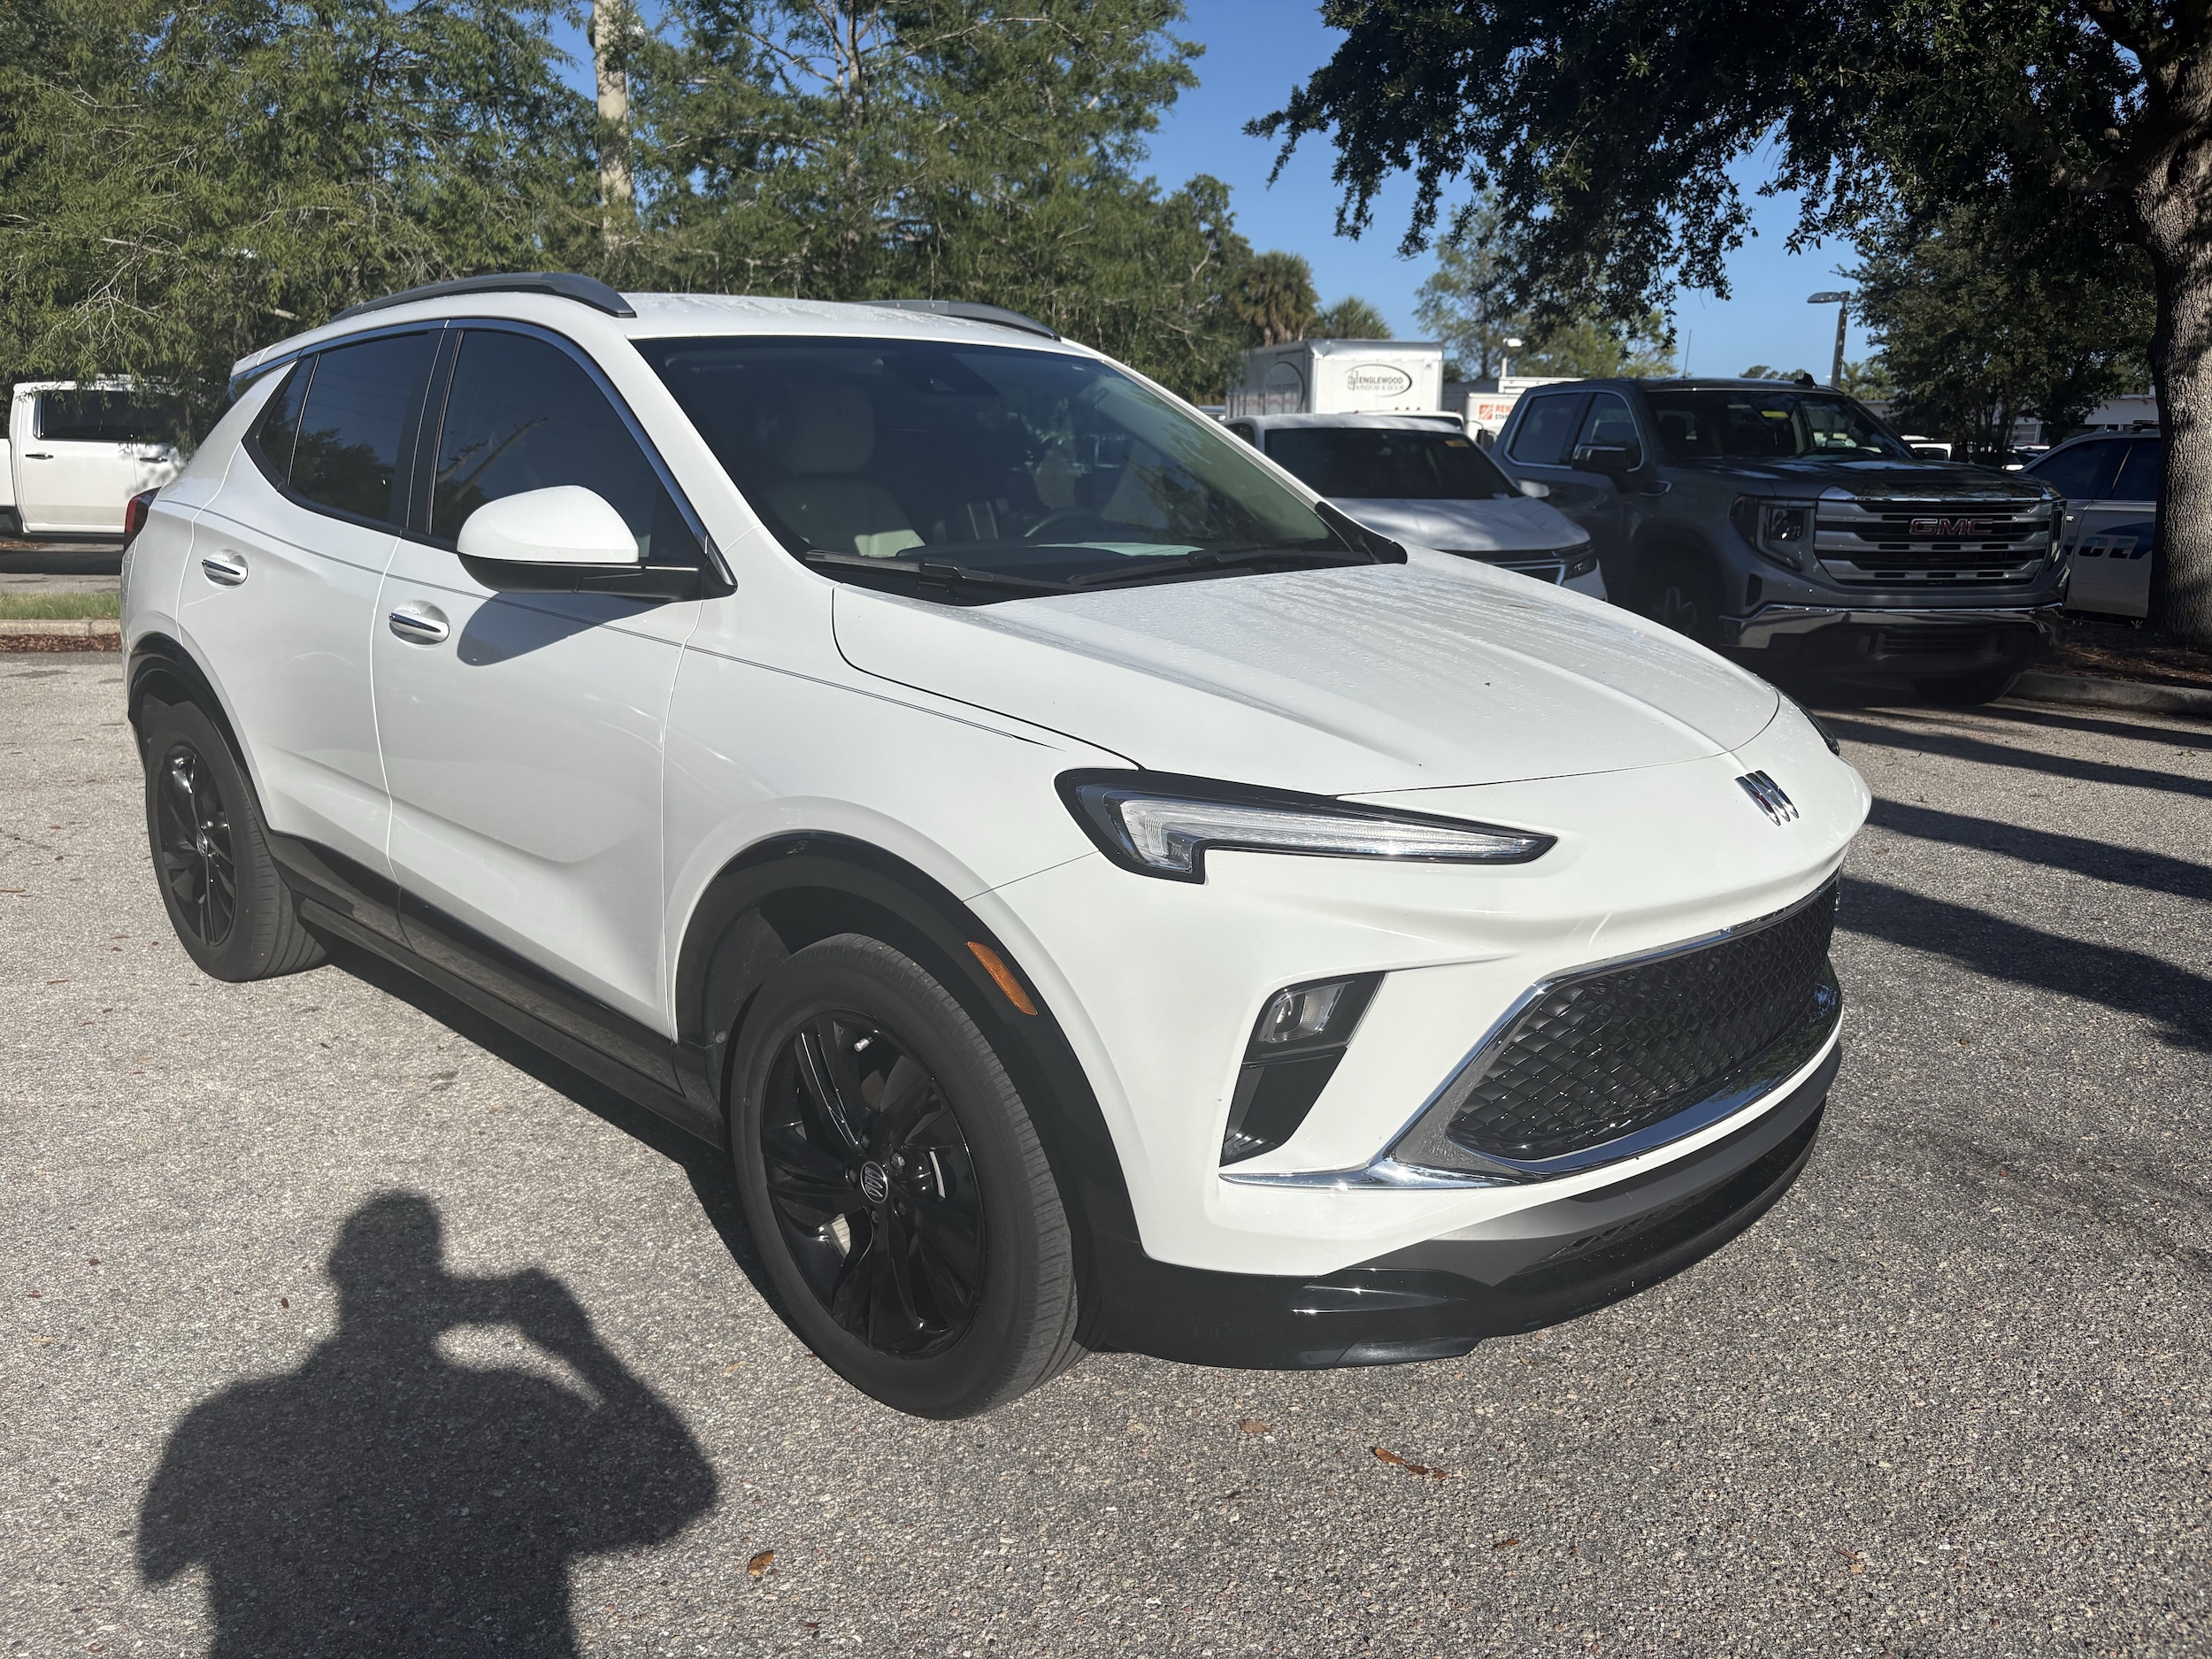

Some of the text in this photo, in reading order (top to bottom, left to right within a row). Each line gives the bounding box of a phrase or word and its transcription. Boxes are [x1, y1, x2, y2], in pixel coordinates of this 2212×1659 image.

[1359, 375, 1404, 384] ENGLEWOOD
[1494, 403, 1512, 413] REN
[1909, 518, 1994, 536] GMC
